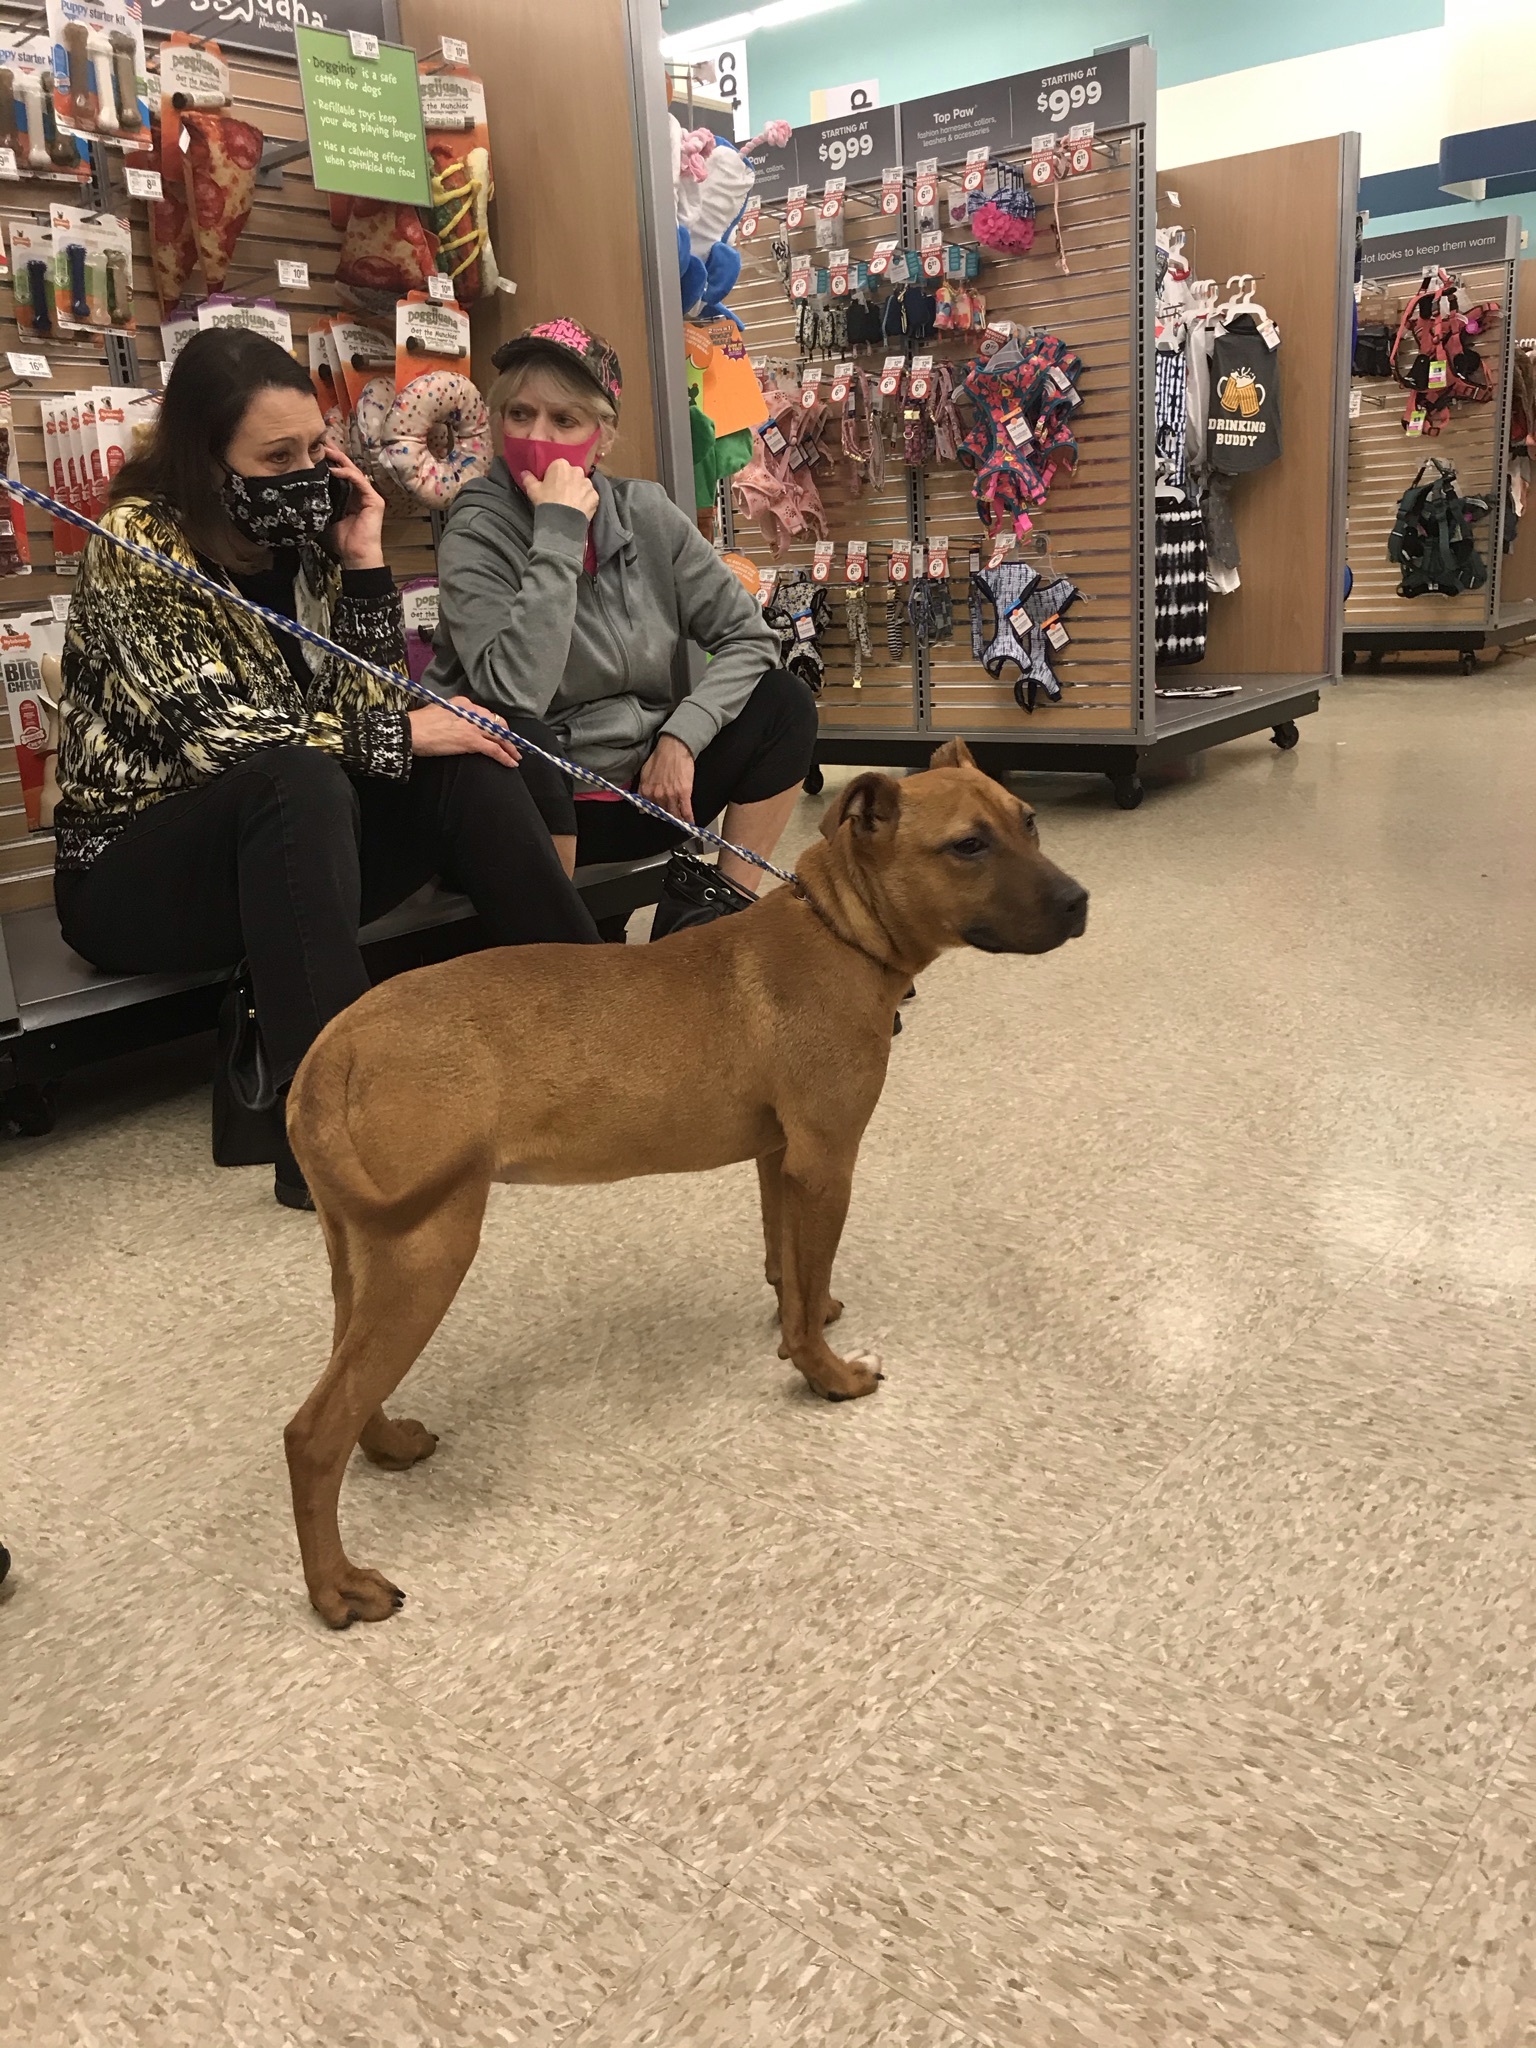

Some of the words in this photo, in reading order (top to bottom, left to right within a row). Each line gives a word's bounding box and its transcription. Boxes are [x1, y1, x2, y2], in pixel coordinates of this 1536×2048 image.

[61, 1, 88, 16] puppy
[89, 8, 114, 22] starter
[115, 13, 126, 26] kit
[0, 49, 16, 60] ppy
[18, 51, 46, 64] starter
[361, 67, 369, 79] is
[372, 72, 377, 80] a
[380, 73, 398, 84] safe
[718, 51, 742, 110] cat
[1041, 69, 1085, 88] STARTING
[1086, 66, 1098, 77] AT
[315, 74, 341, 89] catnip
[345, 79, 358, 91] for
[362, 82, 382, 98] dogs
[318, 99, 355, 116] Refillable
[358, 109, 376, 121] toys
[378, 111, 397, 126] keep
[427, 102, 438, 110] the
[440, 102, 469, 110] Munchies
[933, 111, 951, 125] Top
[320, 116, 339, 127] your
[342, 118, 358, 133] dog
[360, 122, 389, 139] playing
[392, 128, 417, 142] longer
[821, 123, 857, 140] STARTING
[859, 121, 869, 131] AT
[917, 127, 939, 140] fashion
[940, 120, 973, 135] harnesses,
[922, 135, 946, 147] leashes
[947, 134, 953, 142] &
[954, 127, 990, 141] accessories
[323, 141, 338, 152] Has
[341, 145, 346, 153] a
[348, 146, 379, 162] calming
[382, 151, 406, 165] effect
[325, 155, 345, 166] when
[348, 160, 383, 174] sprinkled
[385, 167, 395, 175] on
[398, 167, 416, 179] food
[1377, 250, 1402, 262] looks
[1405, 248, 1414, 257] to
[1416, 244, 1440, 256] keep
[1442, 241, 1467, 252] them
[408, 307, 458, 329] Doggijuana
[411, 327, 422, 336] Get
[435, 331, 458, 340] Munchies
[1208, 418, 1266, 433] DRINKING
[1216, 433, 1258, 447] BUDDY
[4, 661, 41, 682] BIG
[8, 679, 42, 693] CHEW
